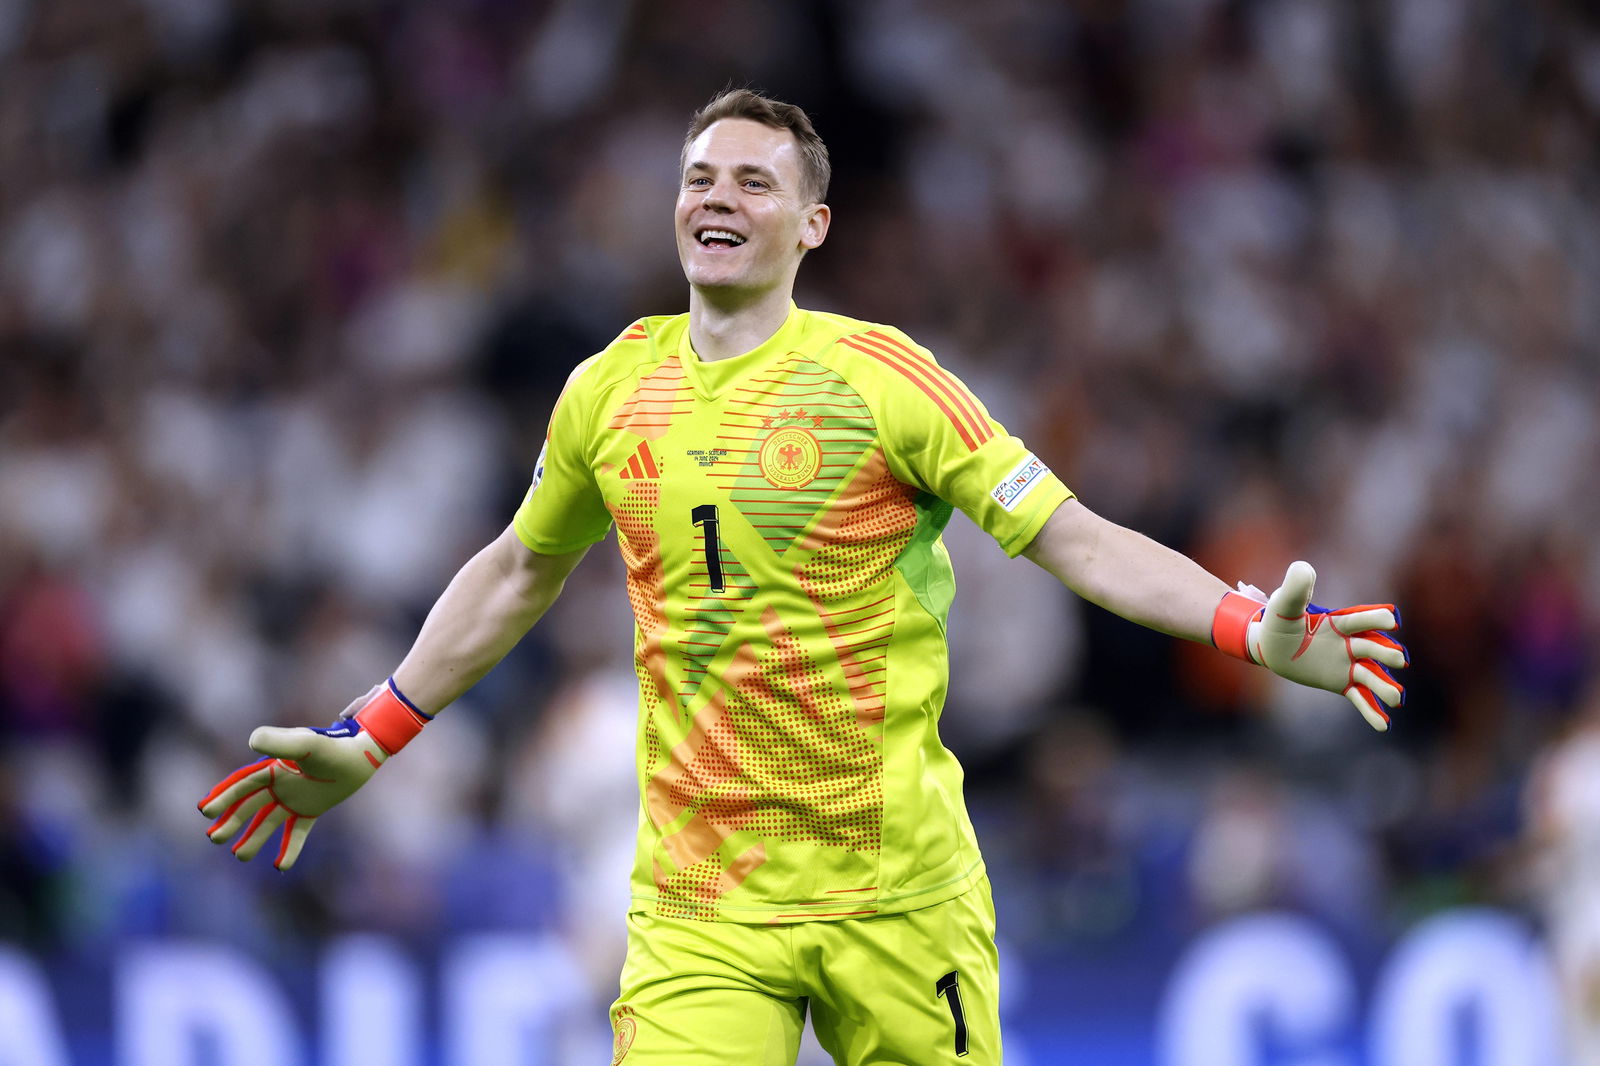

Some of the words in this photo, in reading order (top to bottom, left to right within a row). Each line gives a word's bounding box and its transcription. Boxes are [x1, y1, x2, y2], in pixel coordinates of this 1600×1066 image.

[772, 434, 808, 446] DEUTSCHER
[993, 482, 1008, 498] UEFA
[998, 460, 1042, 505] FOUNDAT
[691, 504, 726, 593] 1
[935, 970, 970, 1058] 1
